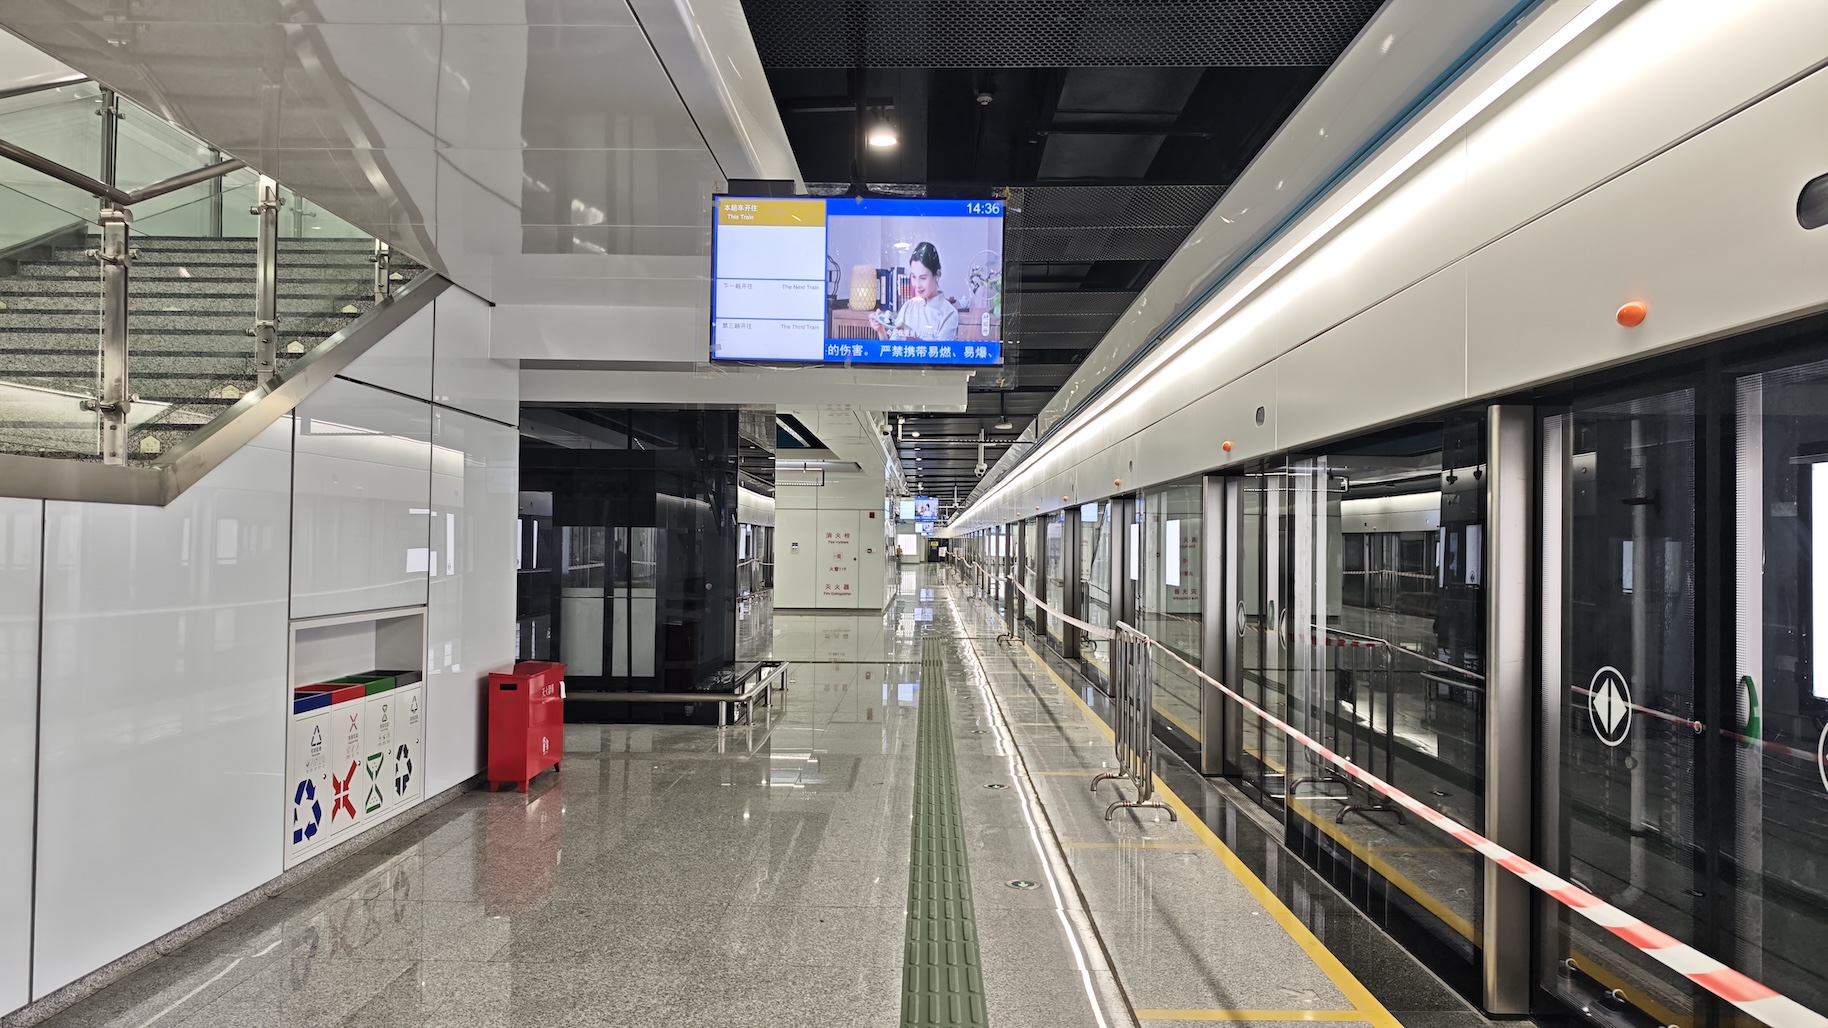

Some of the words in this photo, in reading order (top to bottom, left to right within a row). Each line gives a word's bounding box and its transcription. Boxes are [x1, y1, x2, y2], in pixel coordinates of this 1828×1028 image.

[723, 203, 758, 212] 本趟车开往
[966, 202, 1000, 214] 14:36
[825, 343, 869, 356] 的伤害。
